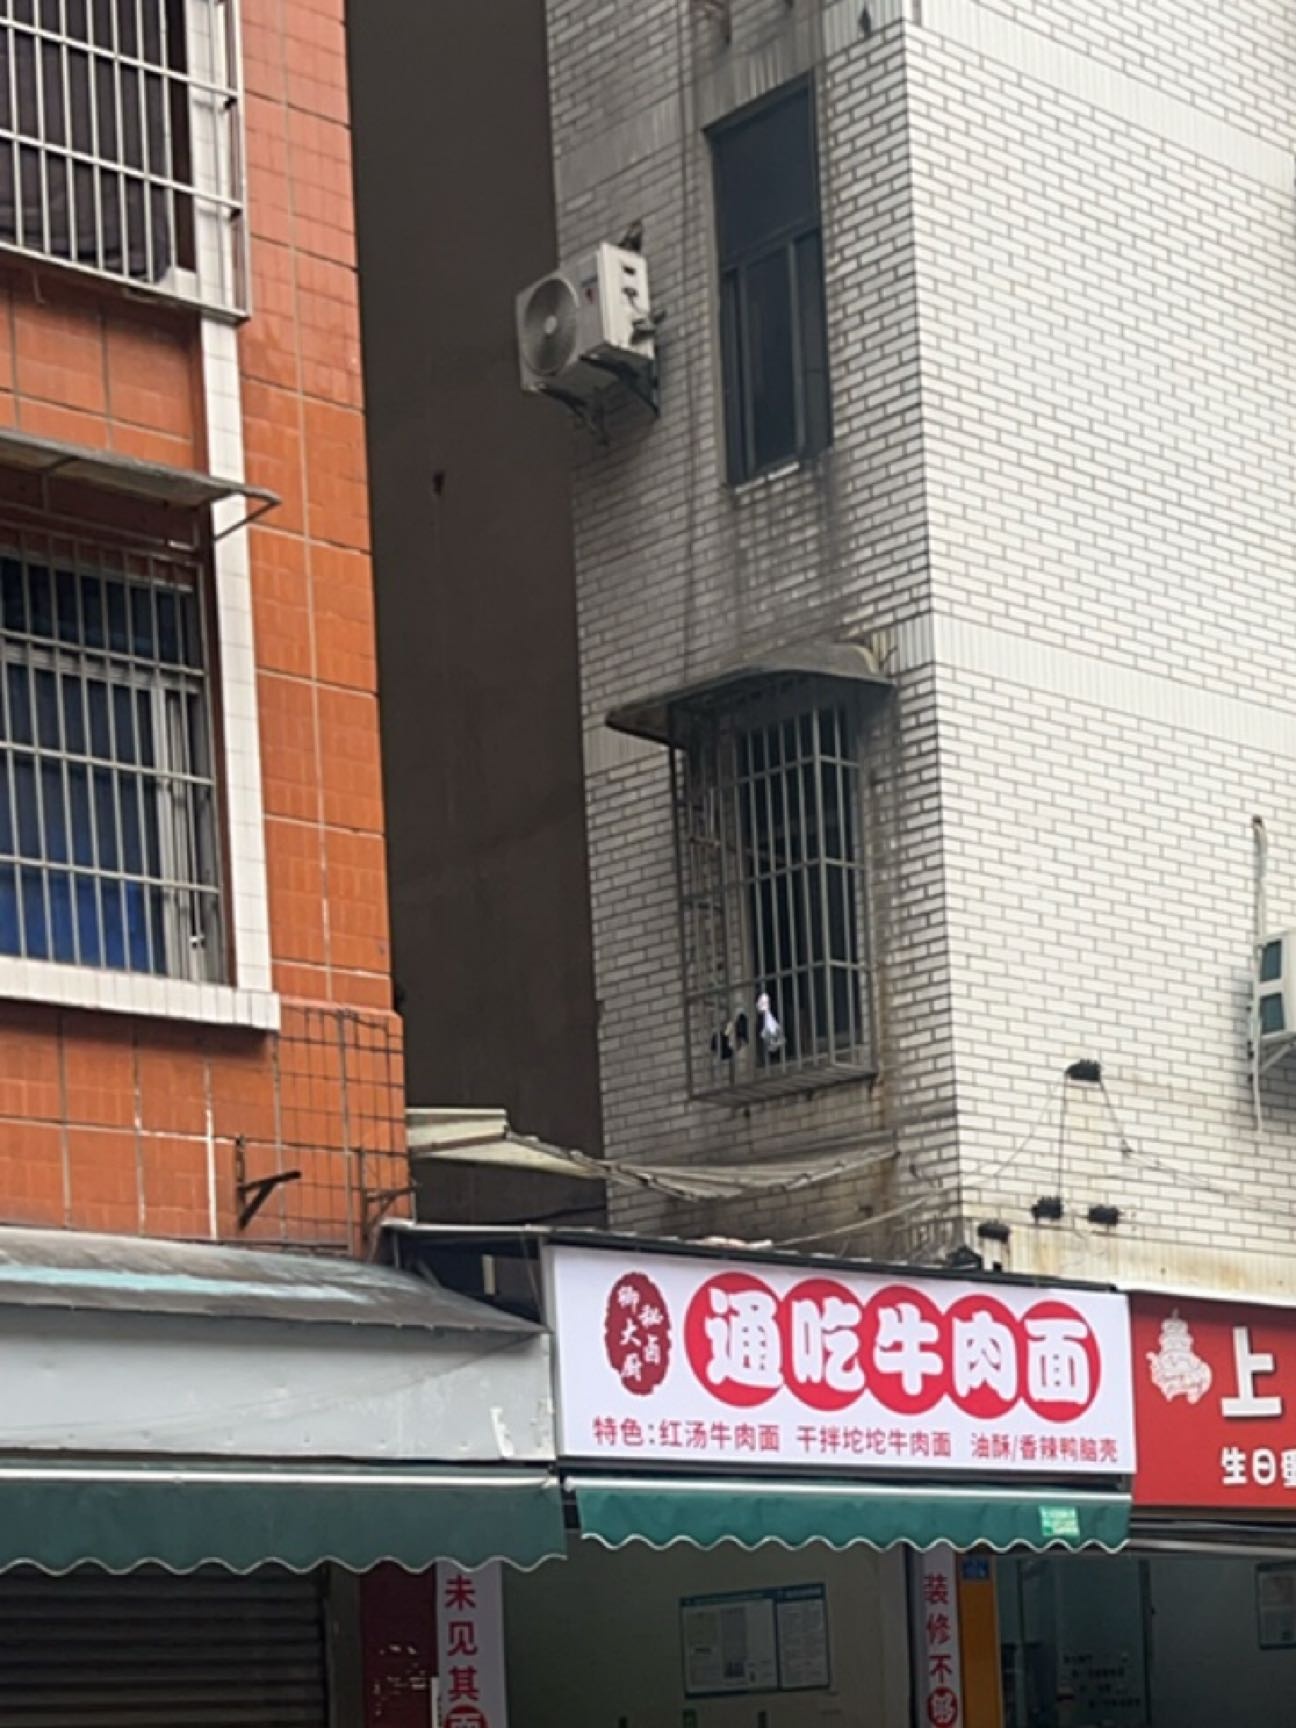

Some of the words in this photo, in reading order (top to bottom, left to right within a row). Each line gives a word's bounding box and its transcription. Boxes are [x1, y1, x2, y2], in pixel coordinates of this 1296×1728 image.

[704, 1288, 1091, 1405] 通吃牛肉面
